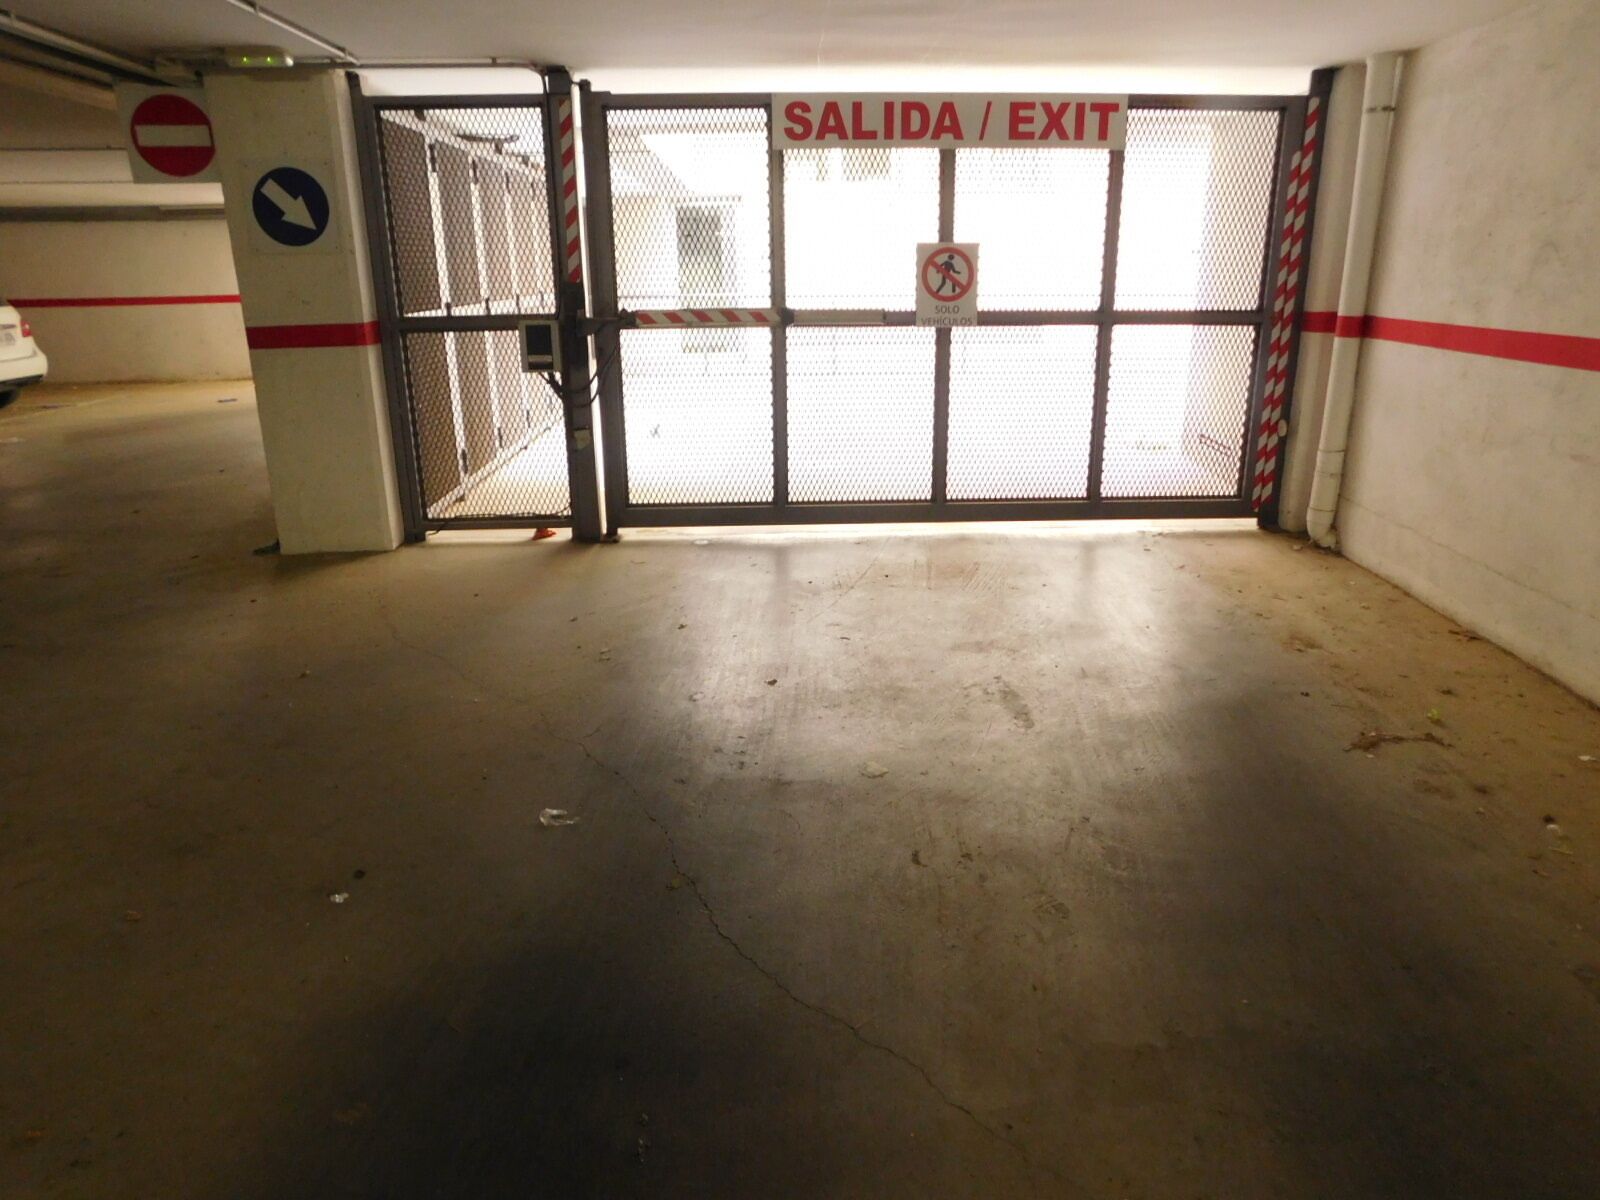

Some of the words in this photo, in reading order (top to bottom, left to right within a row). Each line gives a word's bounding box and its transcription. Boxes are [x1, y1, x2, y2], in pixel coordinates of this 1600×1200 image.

[783, 101, 964, 141] SALIDA
[979, 101, 992, 141] /
[1008, 102, 1120, 141] EXIT
[935, 305, 960, 314] SOLO
